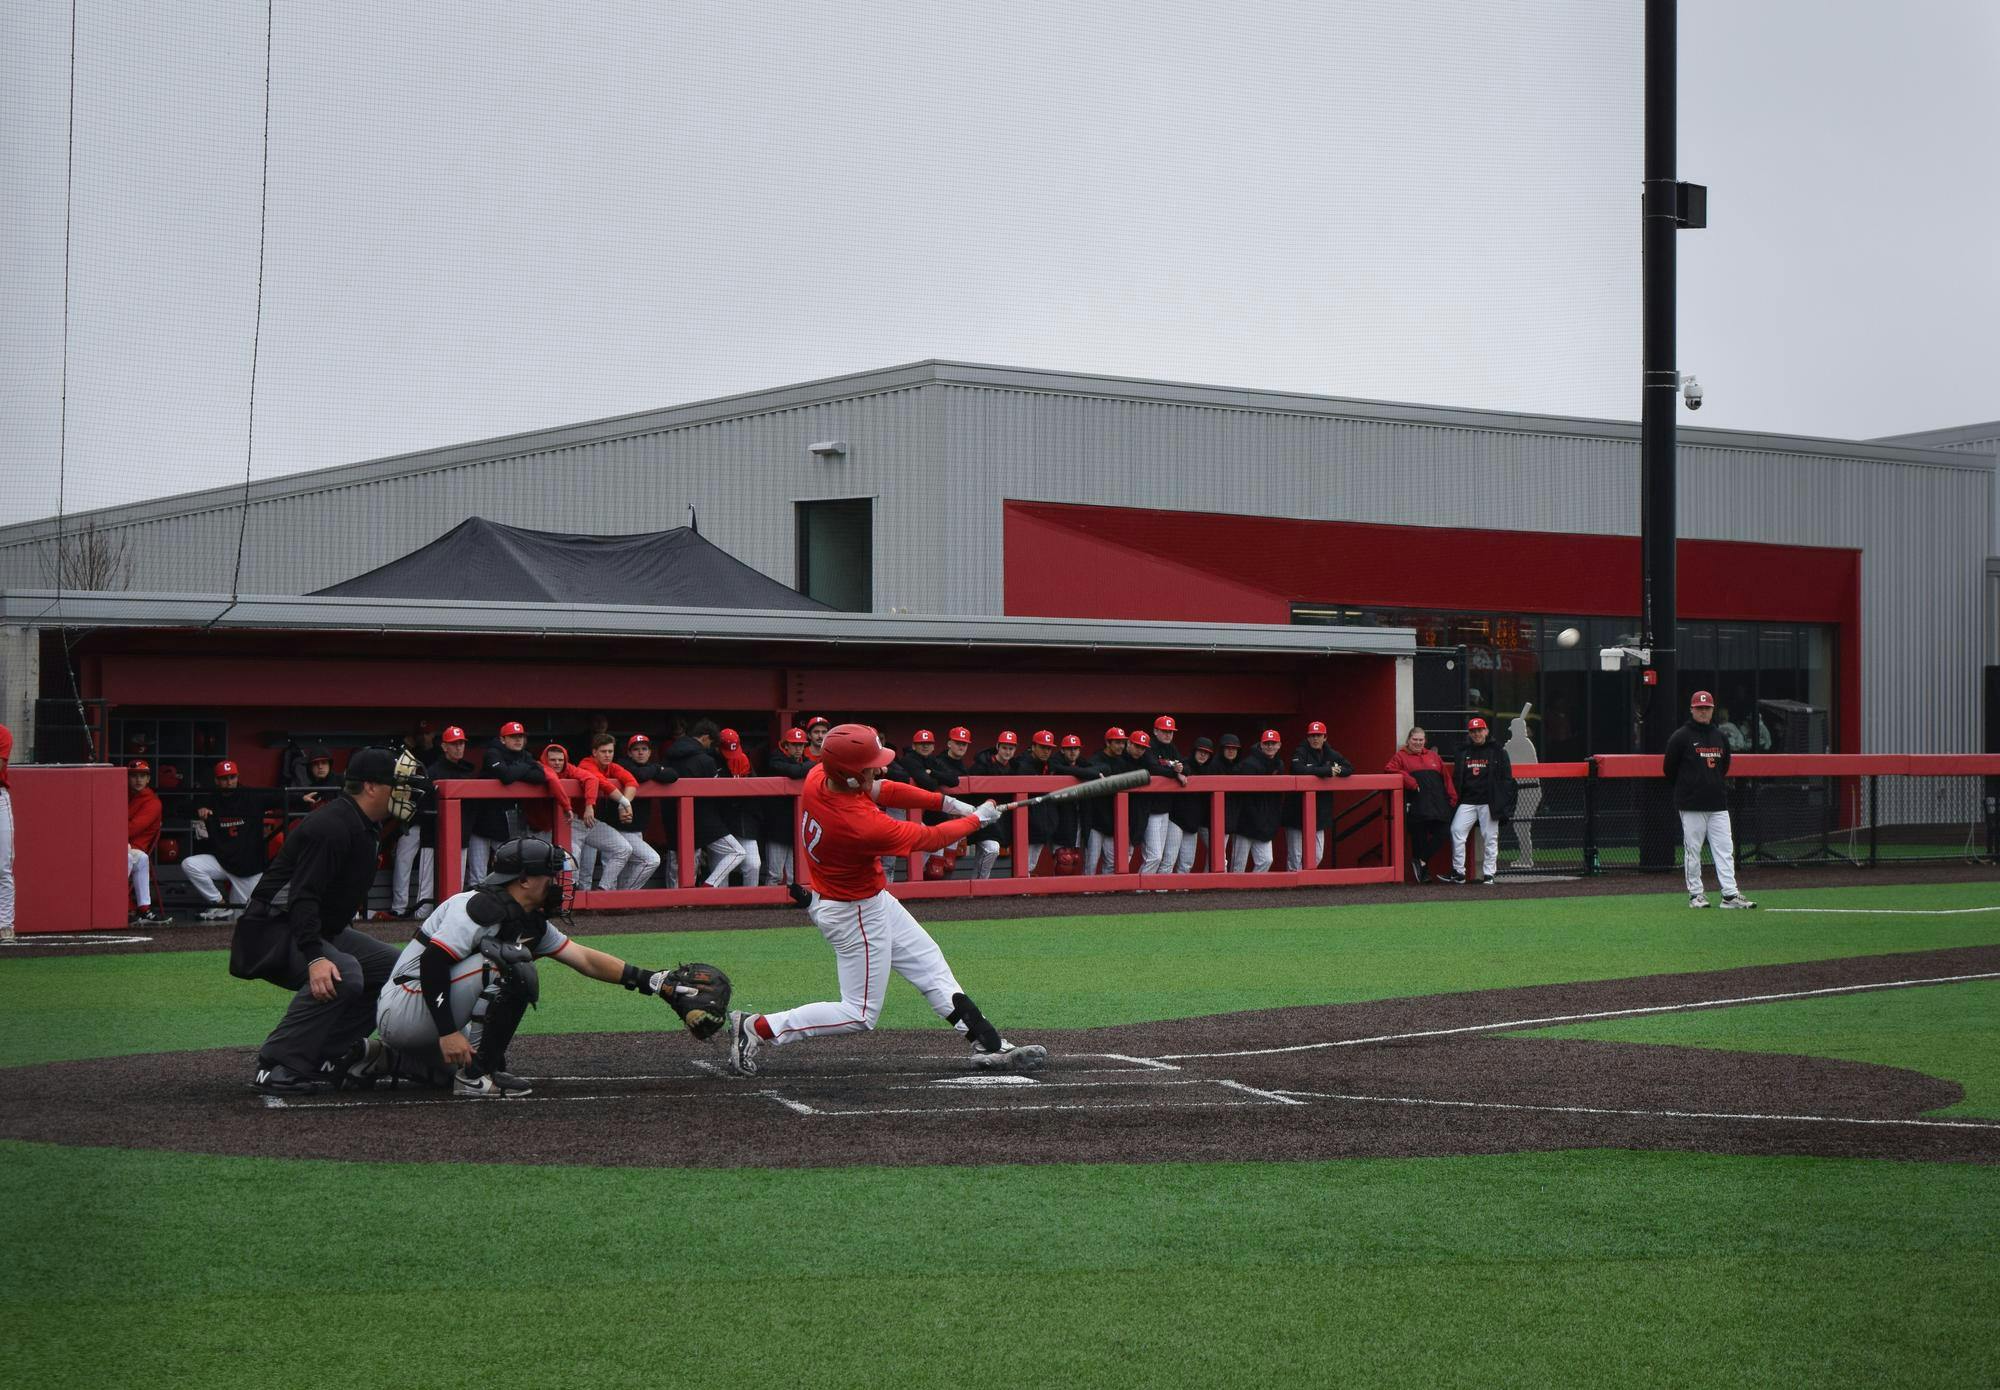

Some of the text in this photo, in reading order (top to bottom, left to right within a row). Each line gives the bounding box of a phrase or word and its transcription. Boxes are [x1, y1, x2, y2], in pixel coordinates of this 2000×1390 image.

[1700, 694, 1707, 702] C
[513, 723, 521, 731] C
[1166, 719, 1173, 727] C
[1313, 723, 1320, 731] C
[453, 728, 461, 736] C
[795, 730, 802, 739] C
[922, 732, 929, 740] C
[959, 730, 966, 738] C
[1006, 732, 1013, 740] C
[1117, 728, 1125, 736] C
[1045, 734, 1052, 742] C
[1140, 734, 1147, 743] C
[730, 742, 737, 750] C
[224, 763, 232, 771] C
[1706, 758, 1716, 768] C
[320, 1060, 336, 1072] N
[256, 1069, 271, 1084] N
